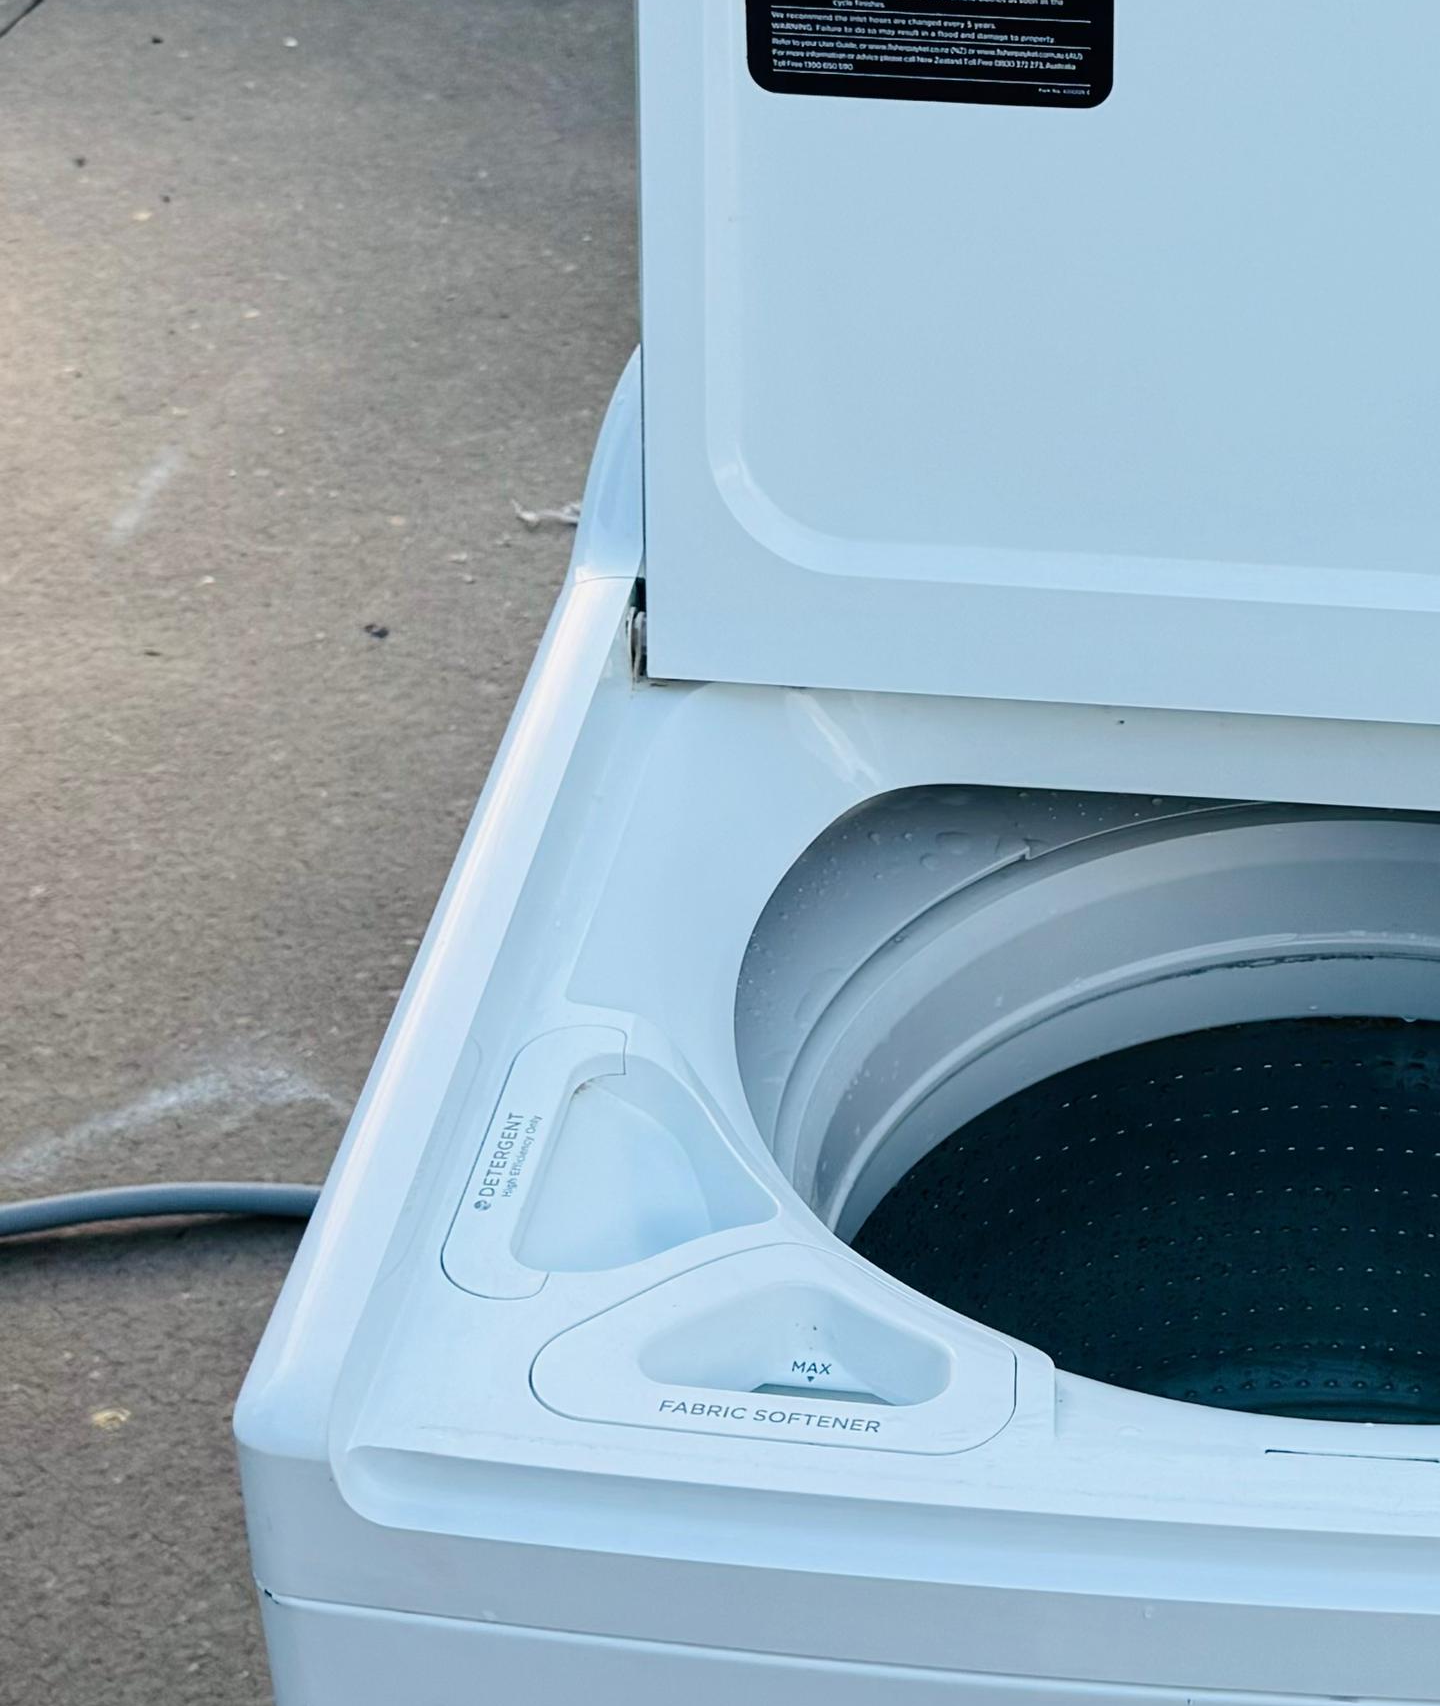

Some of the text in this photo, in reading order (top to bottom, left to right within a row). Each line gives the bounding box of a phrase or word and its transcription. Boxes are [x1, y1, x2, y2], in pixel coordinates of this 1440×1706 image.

[478, 1112, 524, 1197] DETERGENT
[792, 1360, 832, 1375] MAX
[658, 1399, 881, 1433] FABRIC SOFTENER
